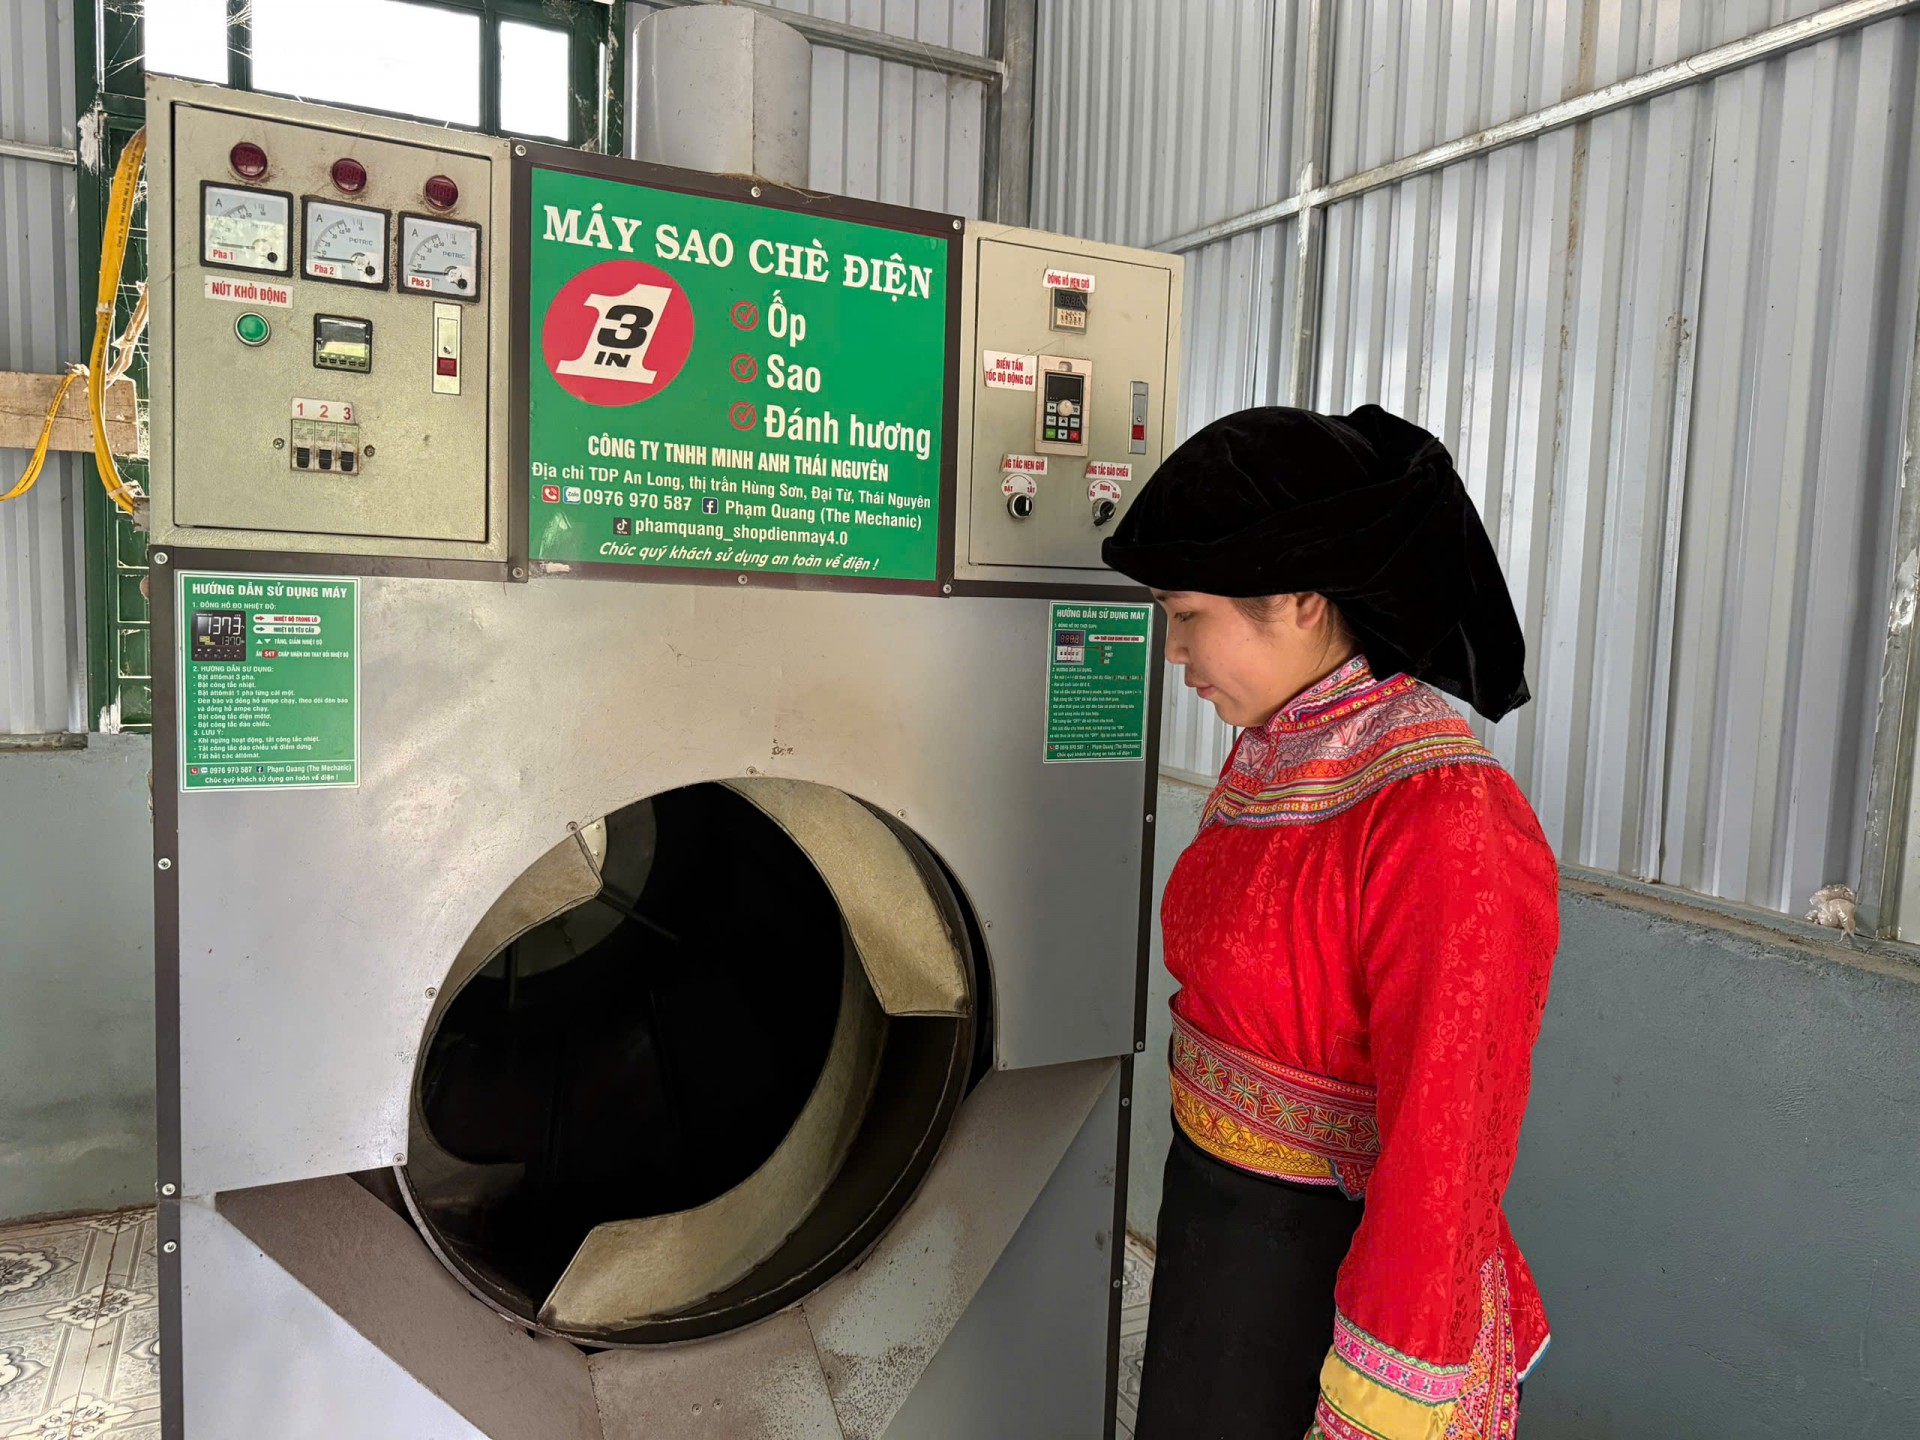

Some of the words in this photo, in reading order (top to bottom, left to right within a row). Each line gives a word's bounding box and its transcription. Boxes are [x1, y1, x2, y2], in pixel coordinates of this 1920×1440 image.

[216, 198, 222, 207] A
[316, 214, 323, 222] A
[213, 249, 228, 260] Pha
[230, 252, 234, 260] 1
[543, 203, 642, 253] MÁY
[655, 224, 734, 267] SAO
[749, 238, 829, 283] CHÈ
[842, 252, 933, 302] ĐIỆN
[314, 264, 328, 273] Pha
[212, 281, 231, 297] NÚT
[234, 282, 257, 300] KHỞI
[260, 287, 287, 304] ĐỘNG
[411, 278, 424, 286] Pha
[597, 304, 654, 349] 3
[768, 289, 806, 347] Ốp
[594, 351, 631, 368] IN
[996, 357, 1010, 370] BIẾN
[767, 354, 821, 393] Sao
[985, 369, 996, 381] TỐC
[998, 371, 1005, 384] ĐỘ
[1008, 372, 1023, 385] ĐỘNG
[1025, 375, 1033, 385] CƠ
[297, 403, 304, 415] 1
[319, 405, 328, 418] 2
[343, 407, 351, 420] 3
[764, 404, 839, 444] Đánh
[849, 414, 931, 460] hương
[588, 432, 635, 459] CÔNG
[640, 440, 660, 461] TY
[664, 442, 707, 465] TNHH
[711, 447, 753, 470] MINH
[757, 453, 789, 473] ANH
[794, 454, 826, 476] THÁI
[831, 459, 888, 482] NGUYÊN
[532, 462, 557, 480] Địa
[562, 465, 584, 480] chỉ
[589, 467, 619, 482] TDP
[623, 469, 642, 485] An
[647, 472, 684, 490] Long,
[689, 476, 706, 493] thị
[710, 476, 737, 493] trấn
[742, 480, 774, 498] Hùng
[779, 483, 807, 500] Sơn,
[811, 486, 832, 501] Đại
[836, 488, 854, 504] Từ,
[859, 490, 884, 505] Thái
[888, 492, 930, 510] Nguyên
[583, 488, 623, 507] 0976
[629, 492, 658, 510] 970
[663, 497, 692, 511] 587
[726, 499, 766, 519] Phạm
[771, 504, 815, 523] Quang
[821, 507, 850, 525] (The
[855, 510, 922, 531] Mechanic)
[635, 517, 848, 547] phamquang_shopdienmay4.0
[599, 542, 636, 556] Chúc
[639, 545, 667, 561] quý
[669, 547, 712, 561] khách
[715, 547, 733, 562] sử
[734, 550, 769, 567] dụng
[772, 555, 788, 565] an
[793, 554, 821, 567] toàn
[825, 554, 843, 568] về
[843, 556, 870, 572] điện
[192, 582, 234, 595] HƯỚNG
[238, 582, 263, 596] DẪN
[267, 582, 284, 596] SỬ
[287, 587, 318, 599] DỤNG
[322, 586, 347, 598] MÁY
